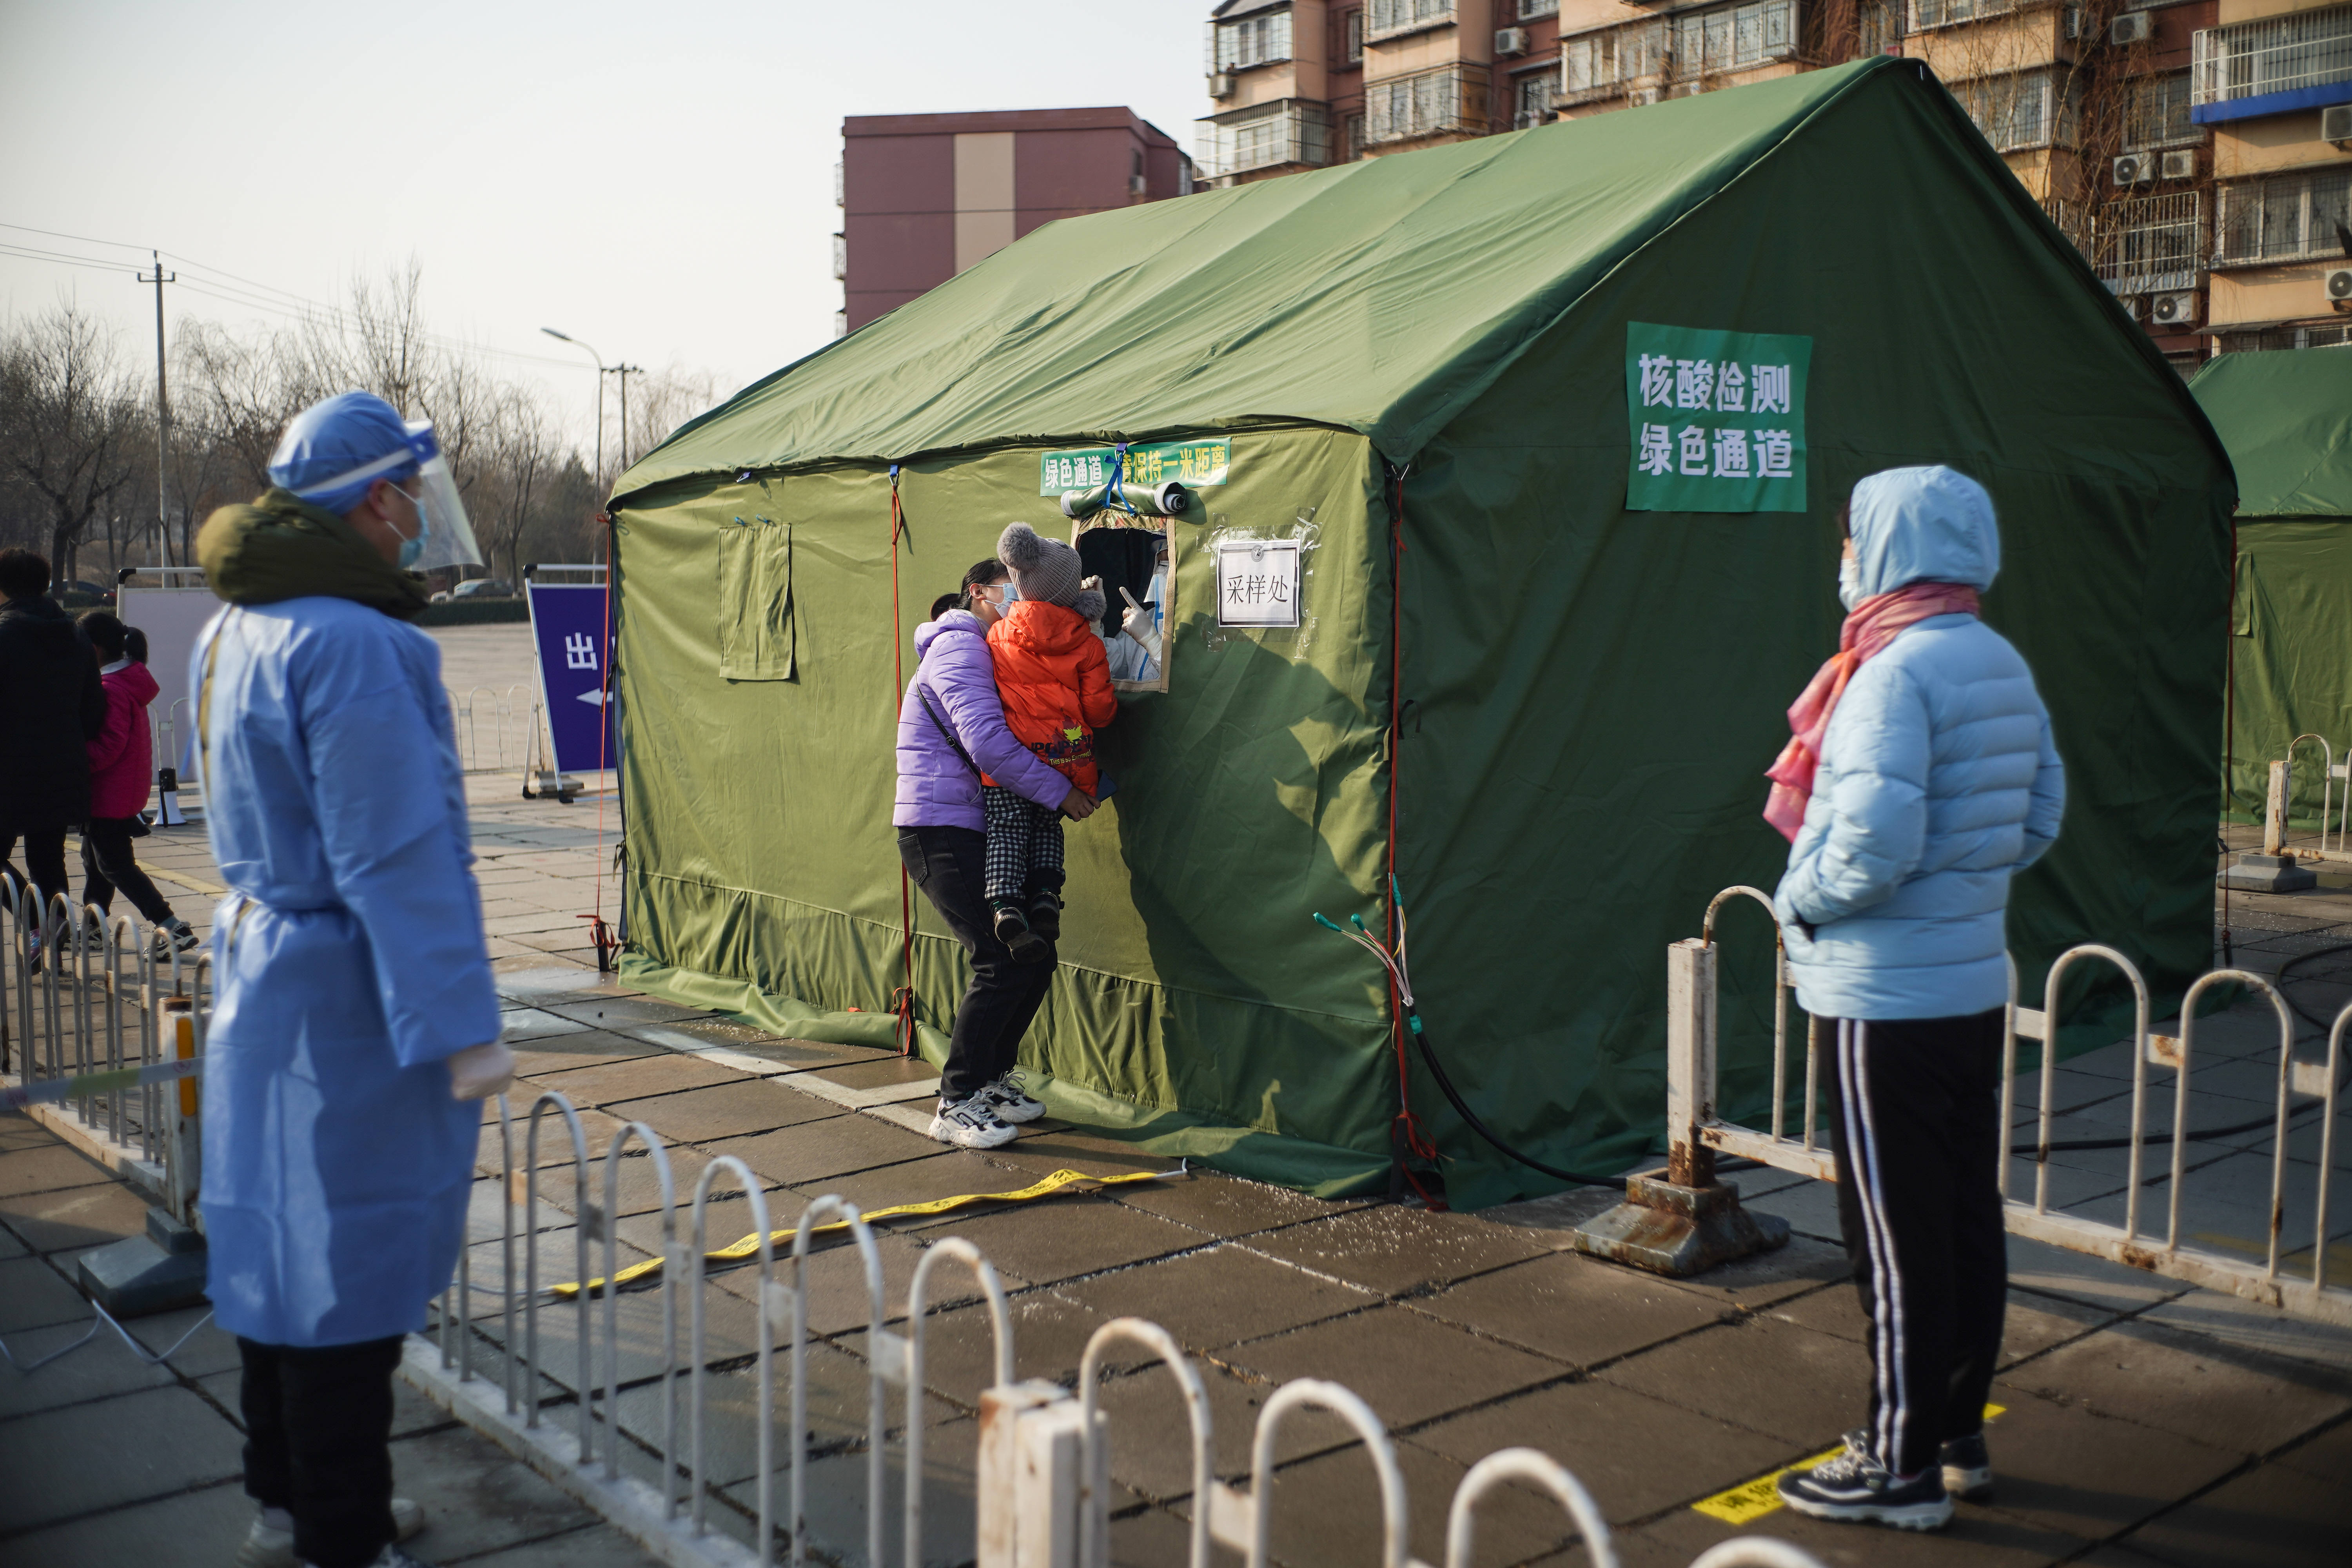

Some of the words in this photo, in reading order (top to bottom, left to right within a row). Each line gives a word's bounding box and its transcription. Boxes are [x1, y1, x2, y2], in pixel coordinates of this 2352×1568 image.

[1638, 354, 1791, 414] 核酸检测
[1638, 423, 1793, 478] 绿色通道
[1045, 456, 1103, 489] 绿色通道
[1226, 574, 1288, 604] 采样处
[565, 632, 615, 670] 出
